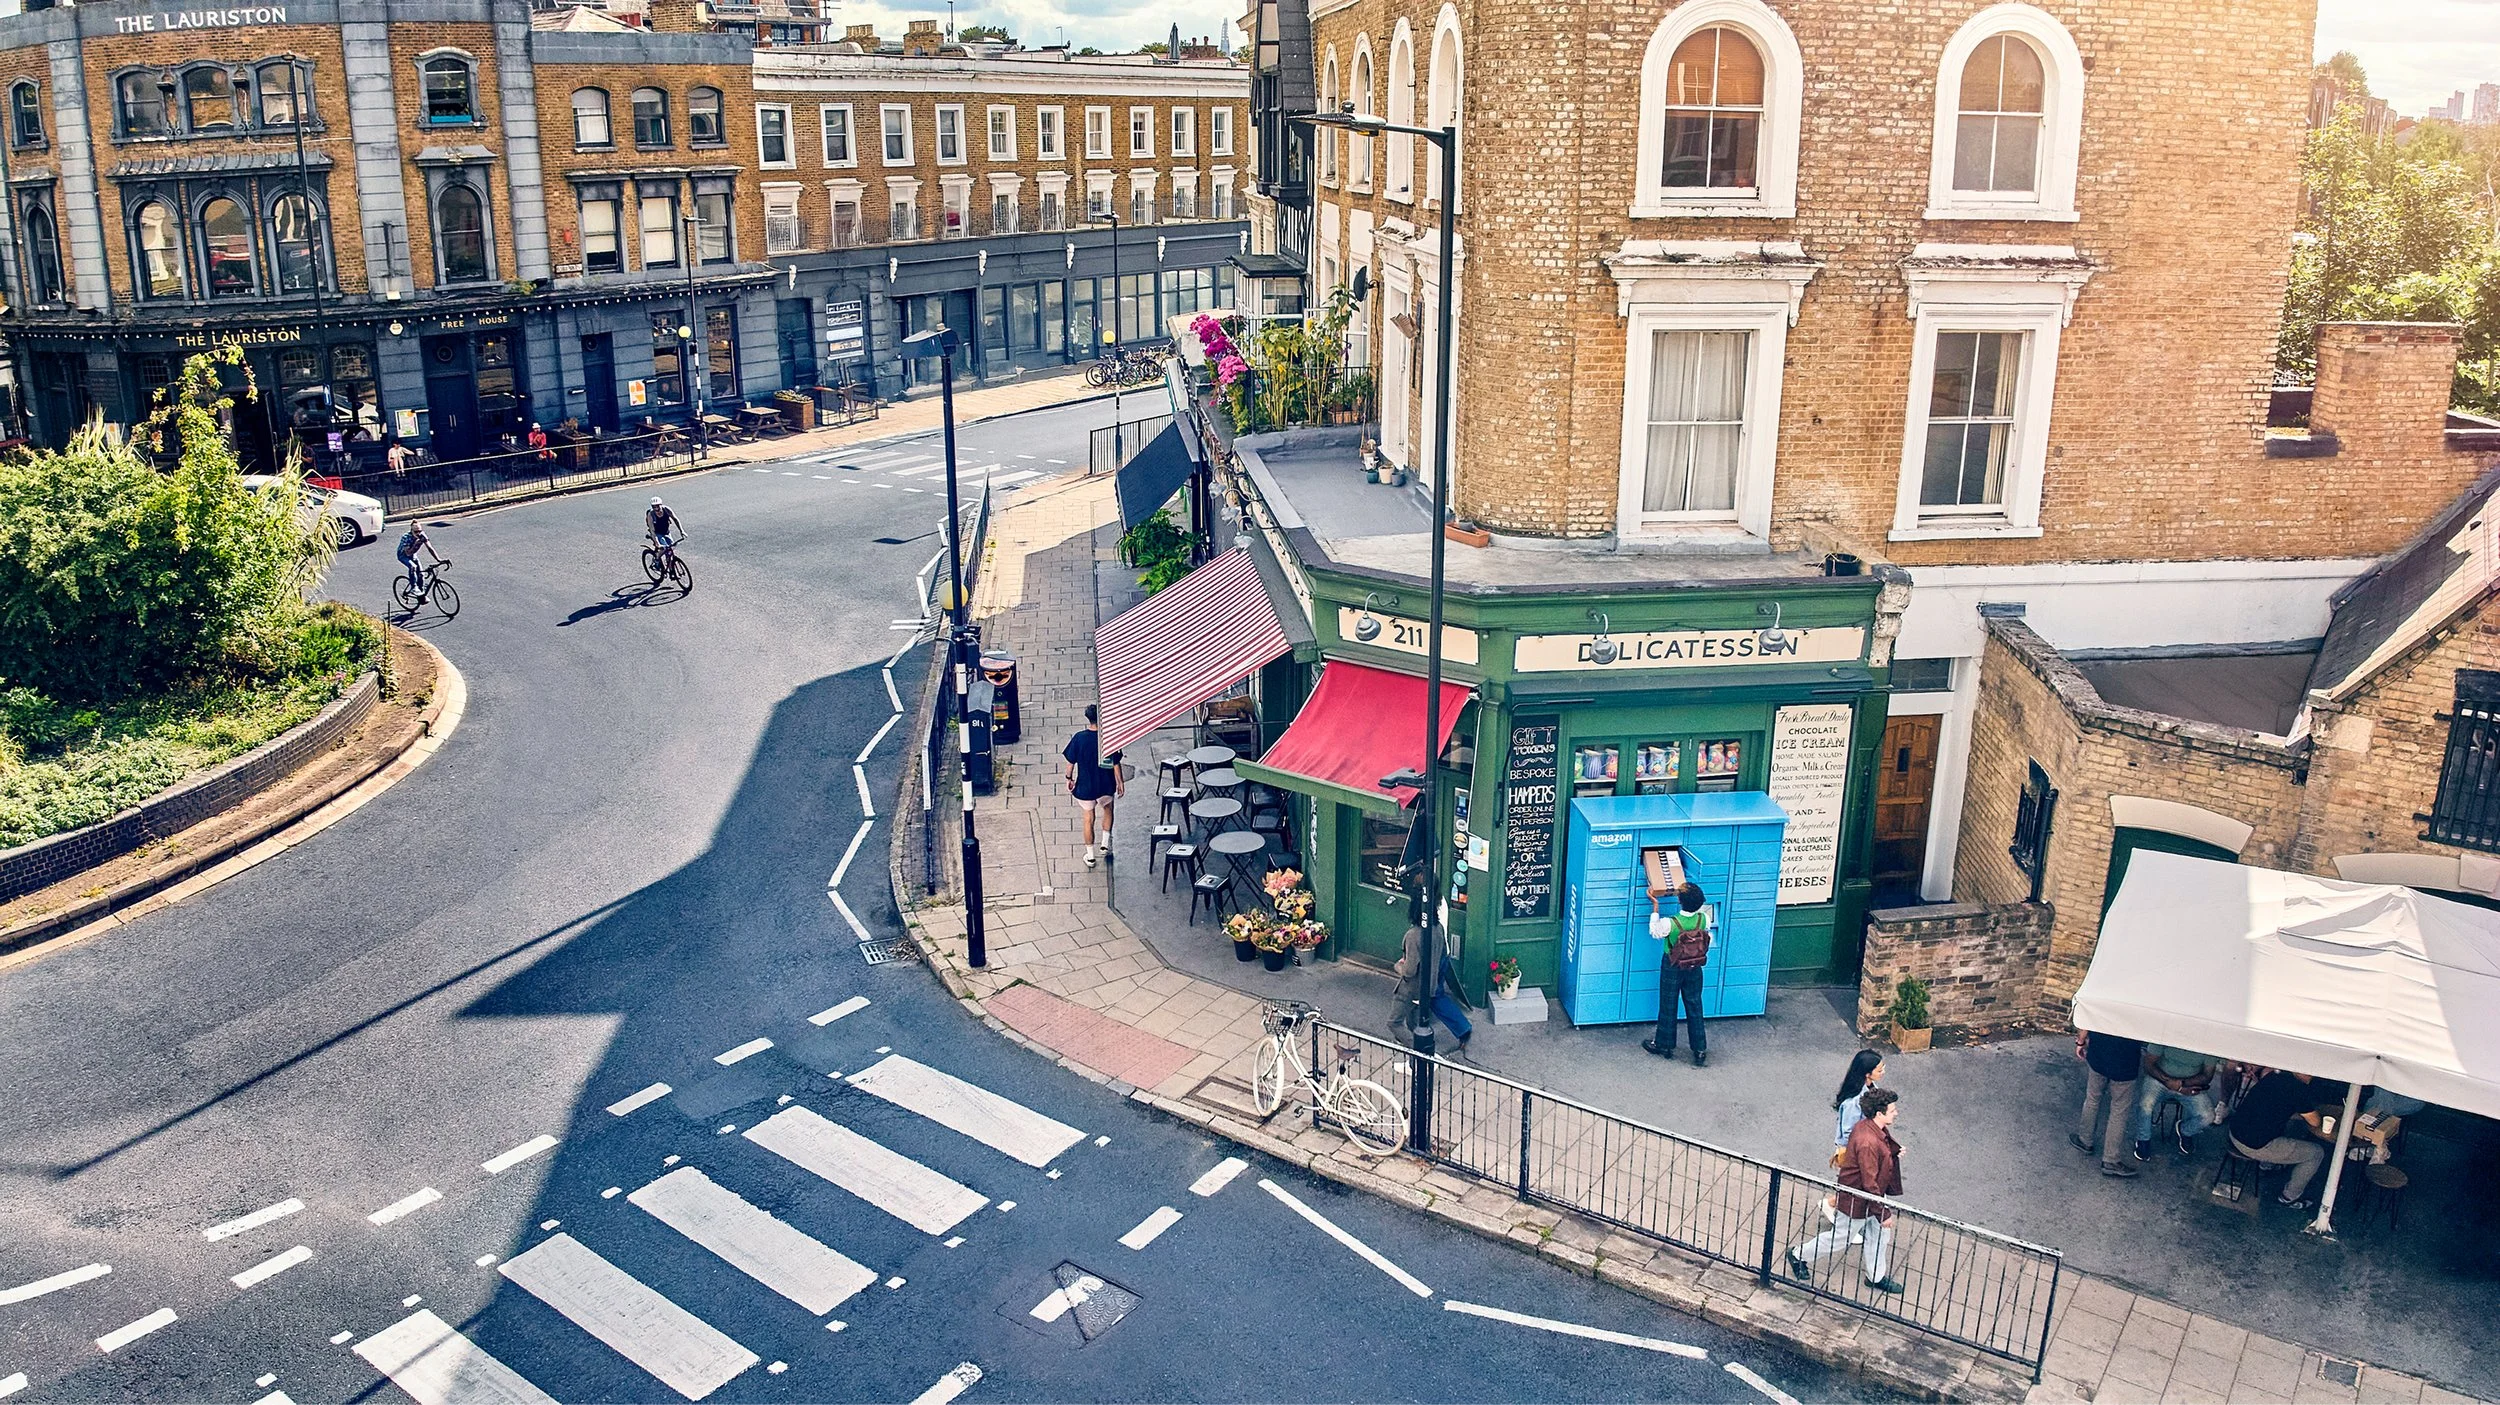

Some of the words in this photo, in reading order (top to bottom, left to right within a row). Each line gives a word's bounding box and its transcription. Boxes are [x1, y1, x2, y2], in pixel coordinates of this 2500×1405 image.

[115, 15, 155, 33] THE
[164, 7, 287, 30] LAURISTON
[441, 319, 465, 329] FREE
[479, 316, 508, 326] HOUSE
[176, 336, 206, 347] THE
[212, 330, 300, 345] LAURISTON
[1393, 624, 1423, 648] 211
[1578, 636, 1799, 662] DLICATESSN
[1778, 711, 1799, 724] Fresh
[1799, 711, 1827, 723] Bread
[1827, 709, 1850, 726] Daily
[1513, 726, 1557, 745] GIFT
[1788, 726, 1838, 735] CHOCOLATE
[1513, 744, 1556, 755] TOKENS
[1776, 739, 1797, 750] ICE
[1802, 737, 1845, 749] CREAM
[1772, 763, 1800, 773] Organic
[1802, 761, 1818, 771] Milk
[1825, 761, 1845, 771] Cream
[1510, 768, 1556, 779] BESPOKE
[1509, 785, 1556, 805] HAMPERS
[1509, 806, 1532, 814] ORDER
[1533, 805, 1554, 813] ONLINE
[1795, 808, 1813, 816] AND
[1515, 834, 1541, 842] BUDGET
[1592, 834, 1632, 843] amazon
[1794, 844, 1831, 852] VEGETABLES
[1520, 853, 1536, 862] OR
[1792, 864, 1830, 874] Continental
[1505, 885, 1527, 896] WRAP
[1528, 884, 1550, 894] THEM
[1567, 884, 1577, 962] amazon
